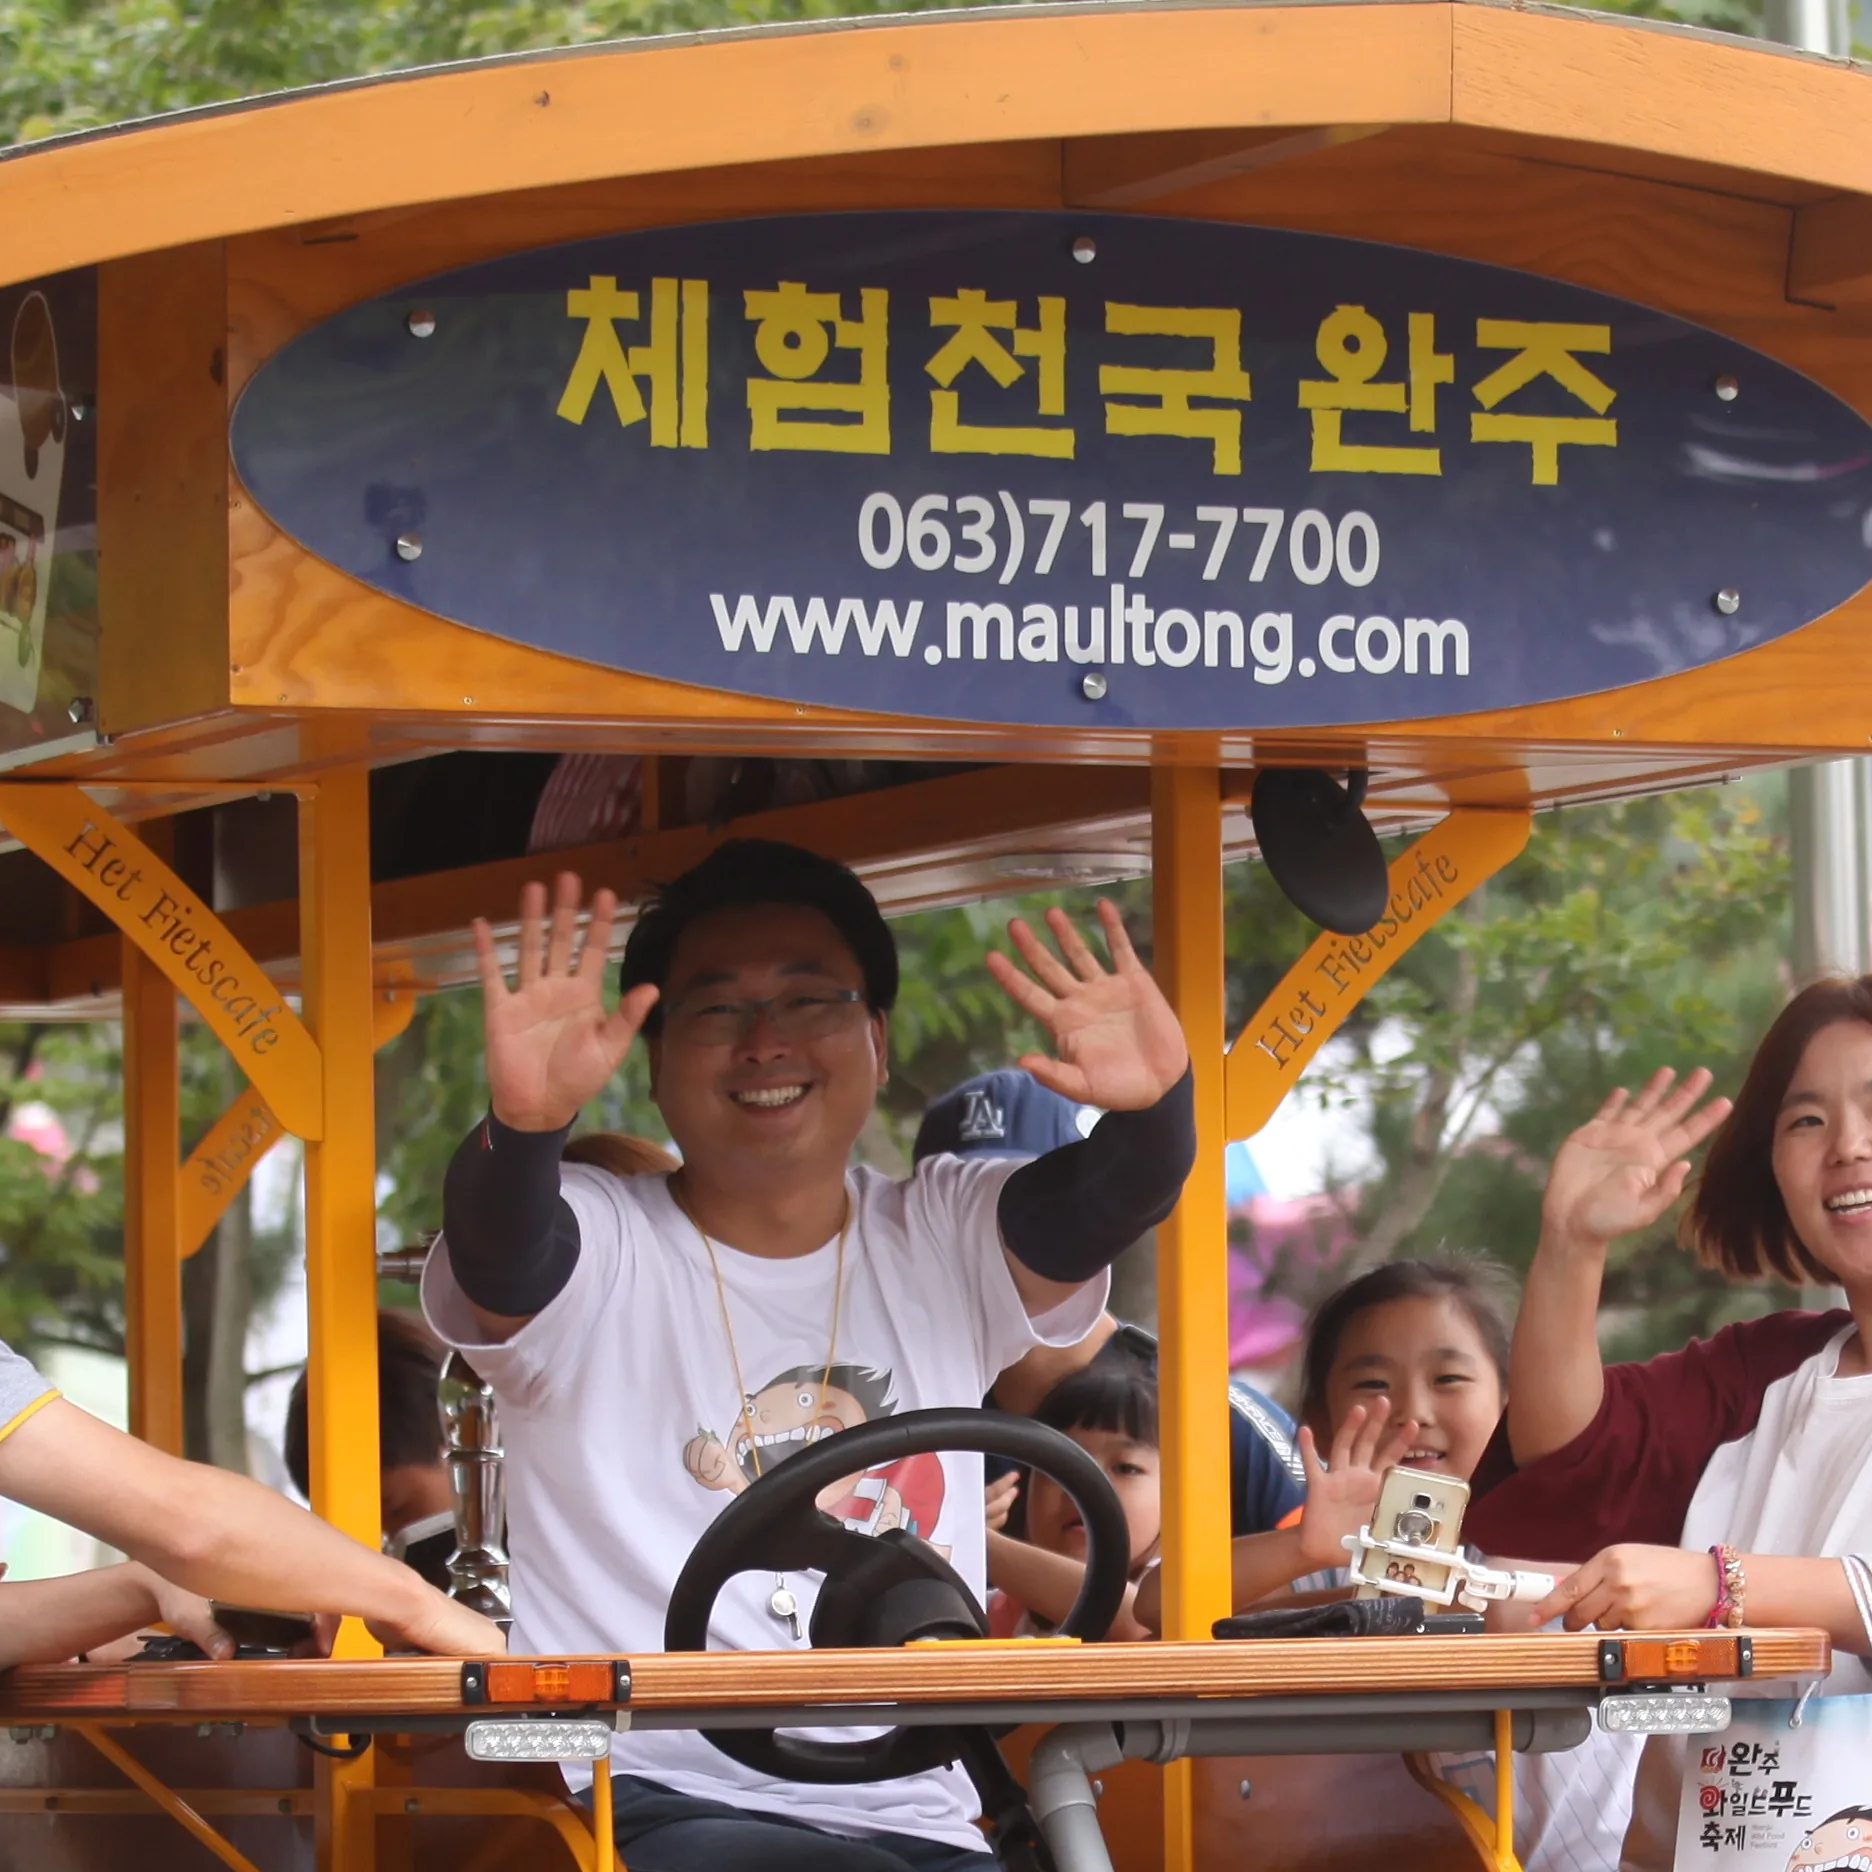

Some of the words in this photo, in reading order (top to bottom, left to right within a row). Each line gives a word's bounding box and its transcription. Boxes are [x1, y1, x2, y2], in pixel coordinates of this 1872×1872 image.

[555, 273, 1252, 476] 체험천국
[1298, 304, 1619, 486] 완주
[856, 491, 1382, 588] 063)717-7700
[711, 584, 1470, 684] www.maultong.com
[63, 820, 142, 902] Het
[138, 888, 285, 1057] Fietscafe
[1255, 989, 1327, 1072] Het
[1698, 1780, 1813, 1818] 와일드푸드
[1727, 1741, 1780, 1776] 완주
[1699, 1820, 1746, 1852] 축제
